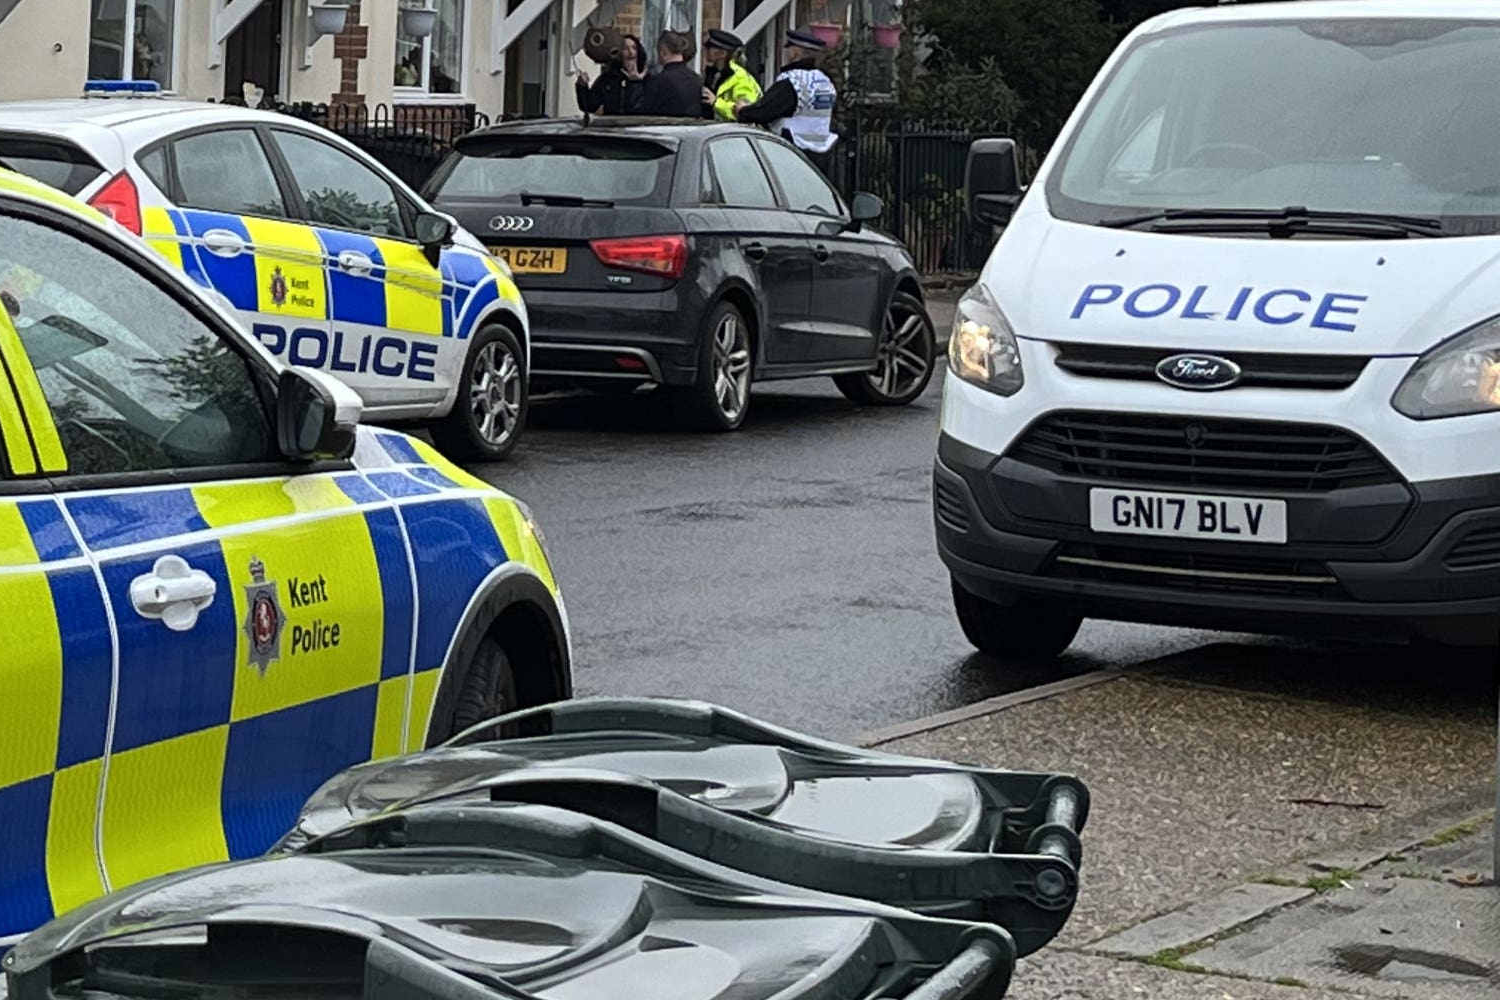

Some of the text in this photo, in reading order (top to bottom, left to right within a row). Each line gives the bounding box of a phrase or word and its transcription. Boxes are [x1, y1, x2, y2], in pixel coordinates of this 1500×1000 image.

[516, 248, 554, 268] GZH
[1069, 283, 1368, 333] POLICE
[253, 323, 438, 382] POLICE
[1112, 494, 1263, 535] GN17 BLV
[287, 573, 328, 608] Kent
[291, 619, 340, 655] Police
